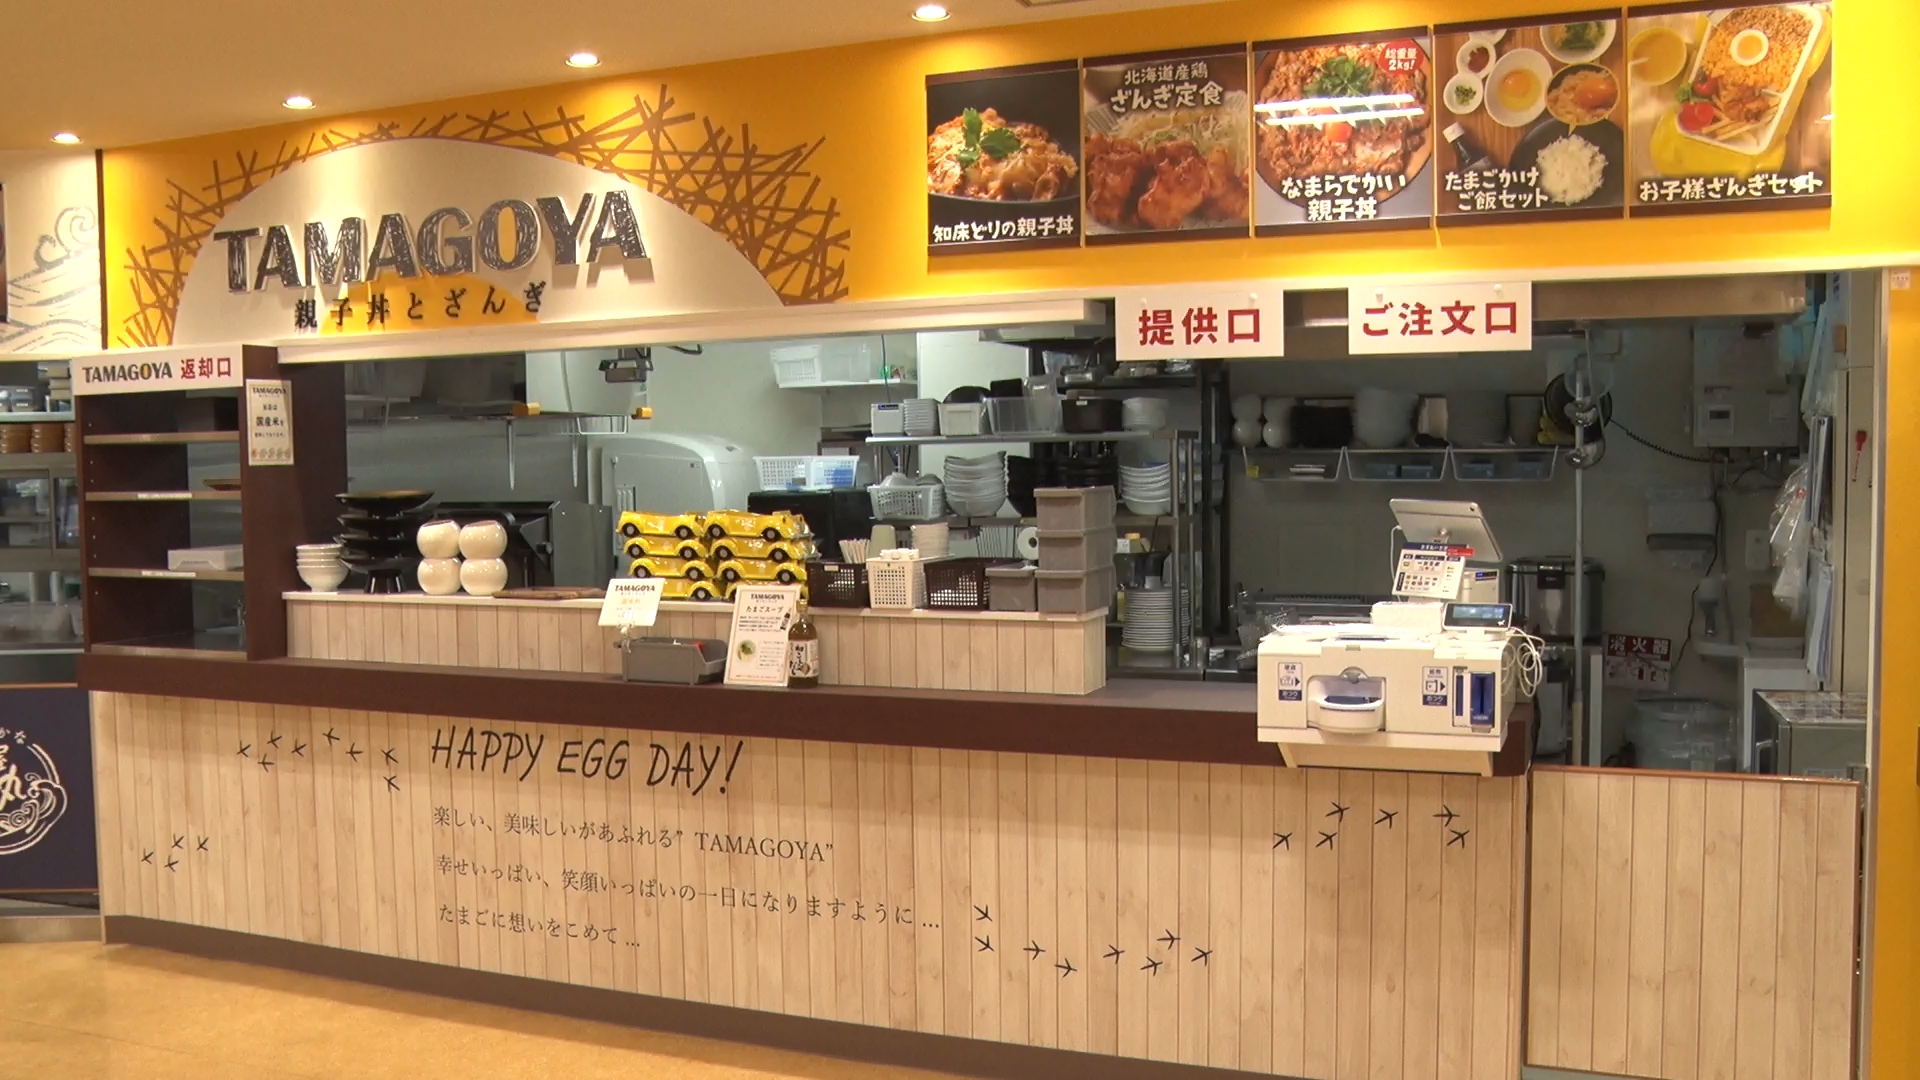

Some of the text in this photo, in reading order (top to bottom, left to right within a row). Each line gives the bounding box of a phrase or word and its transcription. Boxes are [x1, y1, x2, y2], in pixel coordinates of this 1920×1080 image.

[1124, 61, 1209, 85] 北海道産鶏
[1388, 59, 1416, 71] 2kg!
[1110, 81, 1224, 112] ざんぎ定食
[1281, 173, 1406, 200] なまらでかい
[1444, 167, 1540, 192] たまごかけ
[1639, 171, 1823, 202] お子様ざんぎセット
[1307, 197, 1378, 222] 親子丼
[1458, 187, 1549, 212] ご飯セット
[214, 189, 647, 293] TAMAGOYA
[932, 215, 1075, 243] 知床どりの親子丼
[293, 281, 547, 331] 親子丼とざんぎ
[1361, 299, 1518, 338] ご注文口
[1138, 307, 1262, 346] 提供口
[82, 357, 232, 384] TAMAGOYA 返却口
[614, 584, 656, 592] TAMAGOYA
[746, 605, 784, 613] たまごスープ
[431, 725, 744, 797] HAPPY EGG DAY!
